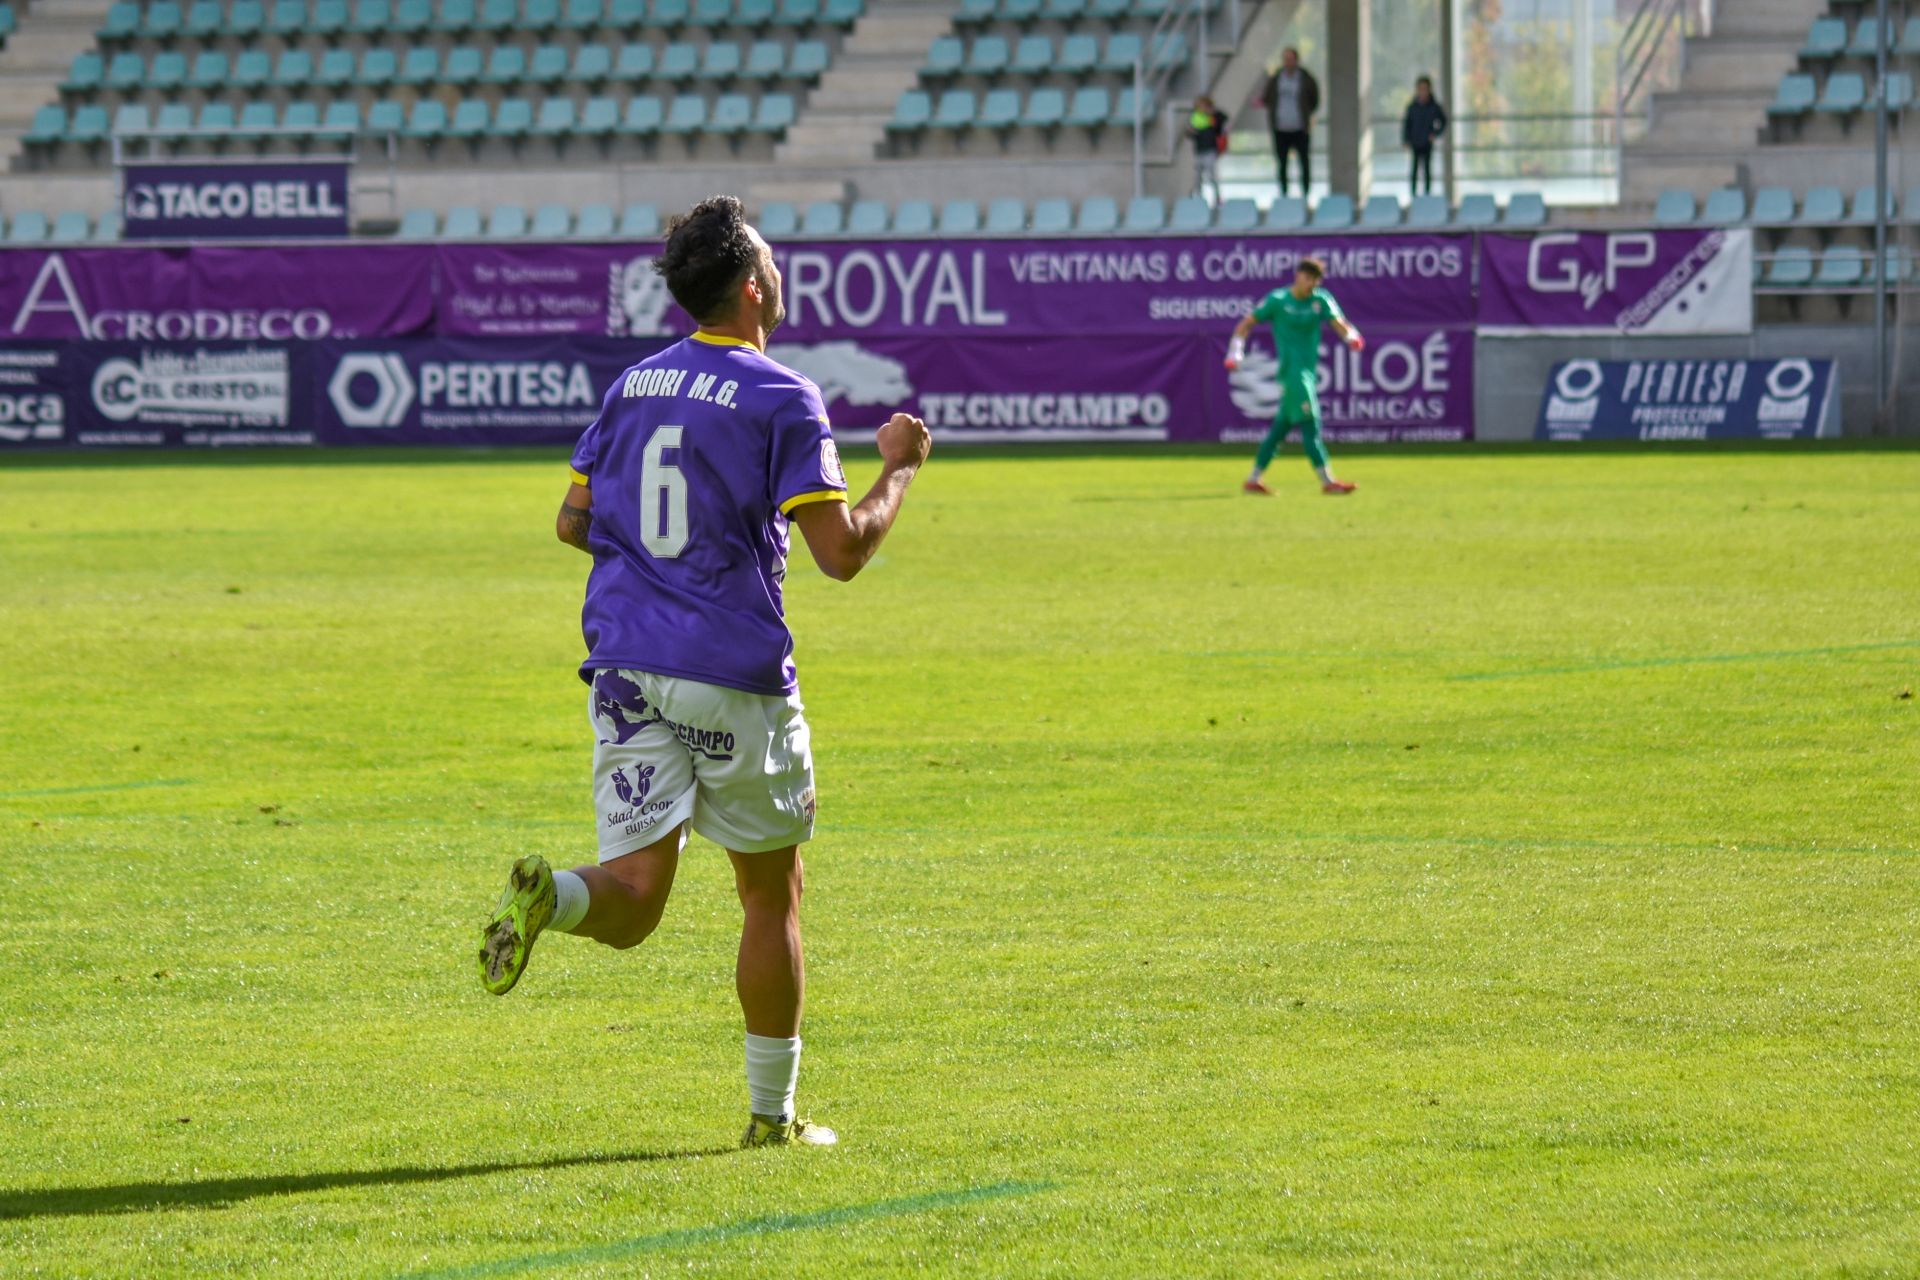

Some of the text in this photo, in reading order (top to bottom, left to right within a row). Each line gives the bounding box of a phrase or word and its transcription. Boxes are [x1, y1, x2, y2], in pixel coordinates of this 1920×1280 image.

[158, 182, 343, 218] TACO BELL
[1010, 250, 1168, 283] VENTANAS
[1174, 249, 1197, 281] &
[776, 251, 1007, 326] ROYAL
[141, 382, 163, 399] EL
[172, 381, 260, 400] CRISTO
[420, 363, 593, 406] PERTESA
[623, 369, 739, 409] RODRI M.G.
[1621, 360, 1748, 402] PERTESA
[919, 393, 1169, 426] TECNICAMPO
[640, 425, 688, 558] 6
[666, 718, 734, 751] CAMPO
[608, 808, 633, 827] Sdad
[625, 816, 656, 835] EUJISA
